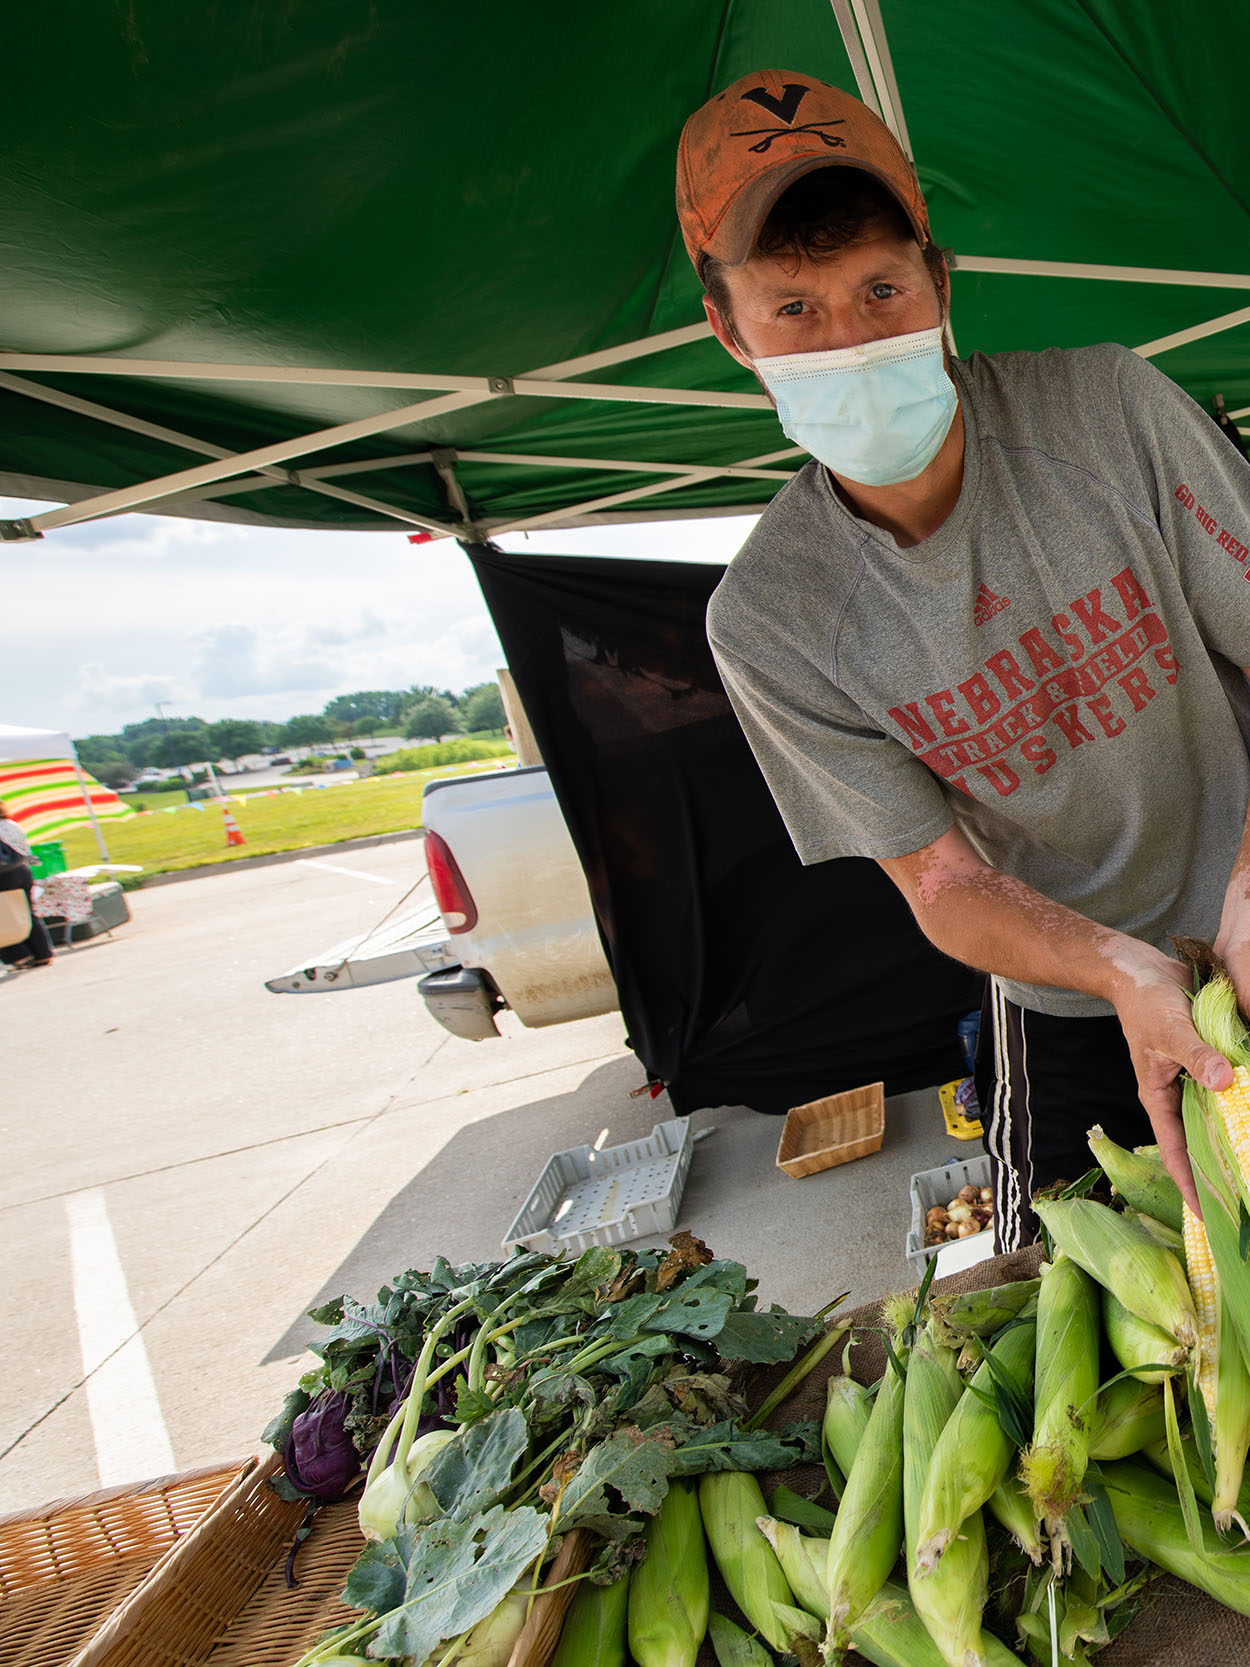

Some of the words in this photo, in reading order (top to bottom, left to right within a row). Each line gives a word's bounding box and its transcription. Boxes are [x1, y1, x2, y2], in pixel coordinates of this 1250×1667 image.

[741, 84, 811, 127] V
[1174, 483, 1196, 511] GO
[1195, 504, 1218, 536] BIG
[887, 566, 1153, 751] NEBRASKA
[939, 701, 1043, 768] TRACK
[1045, 682, 1070, 704] &
